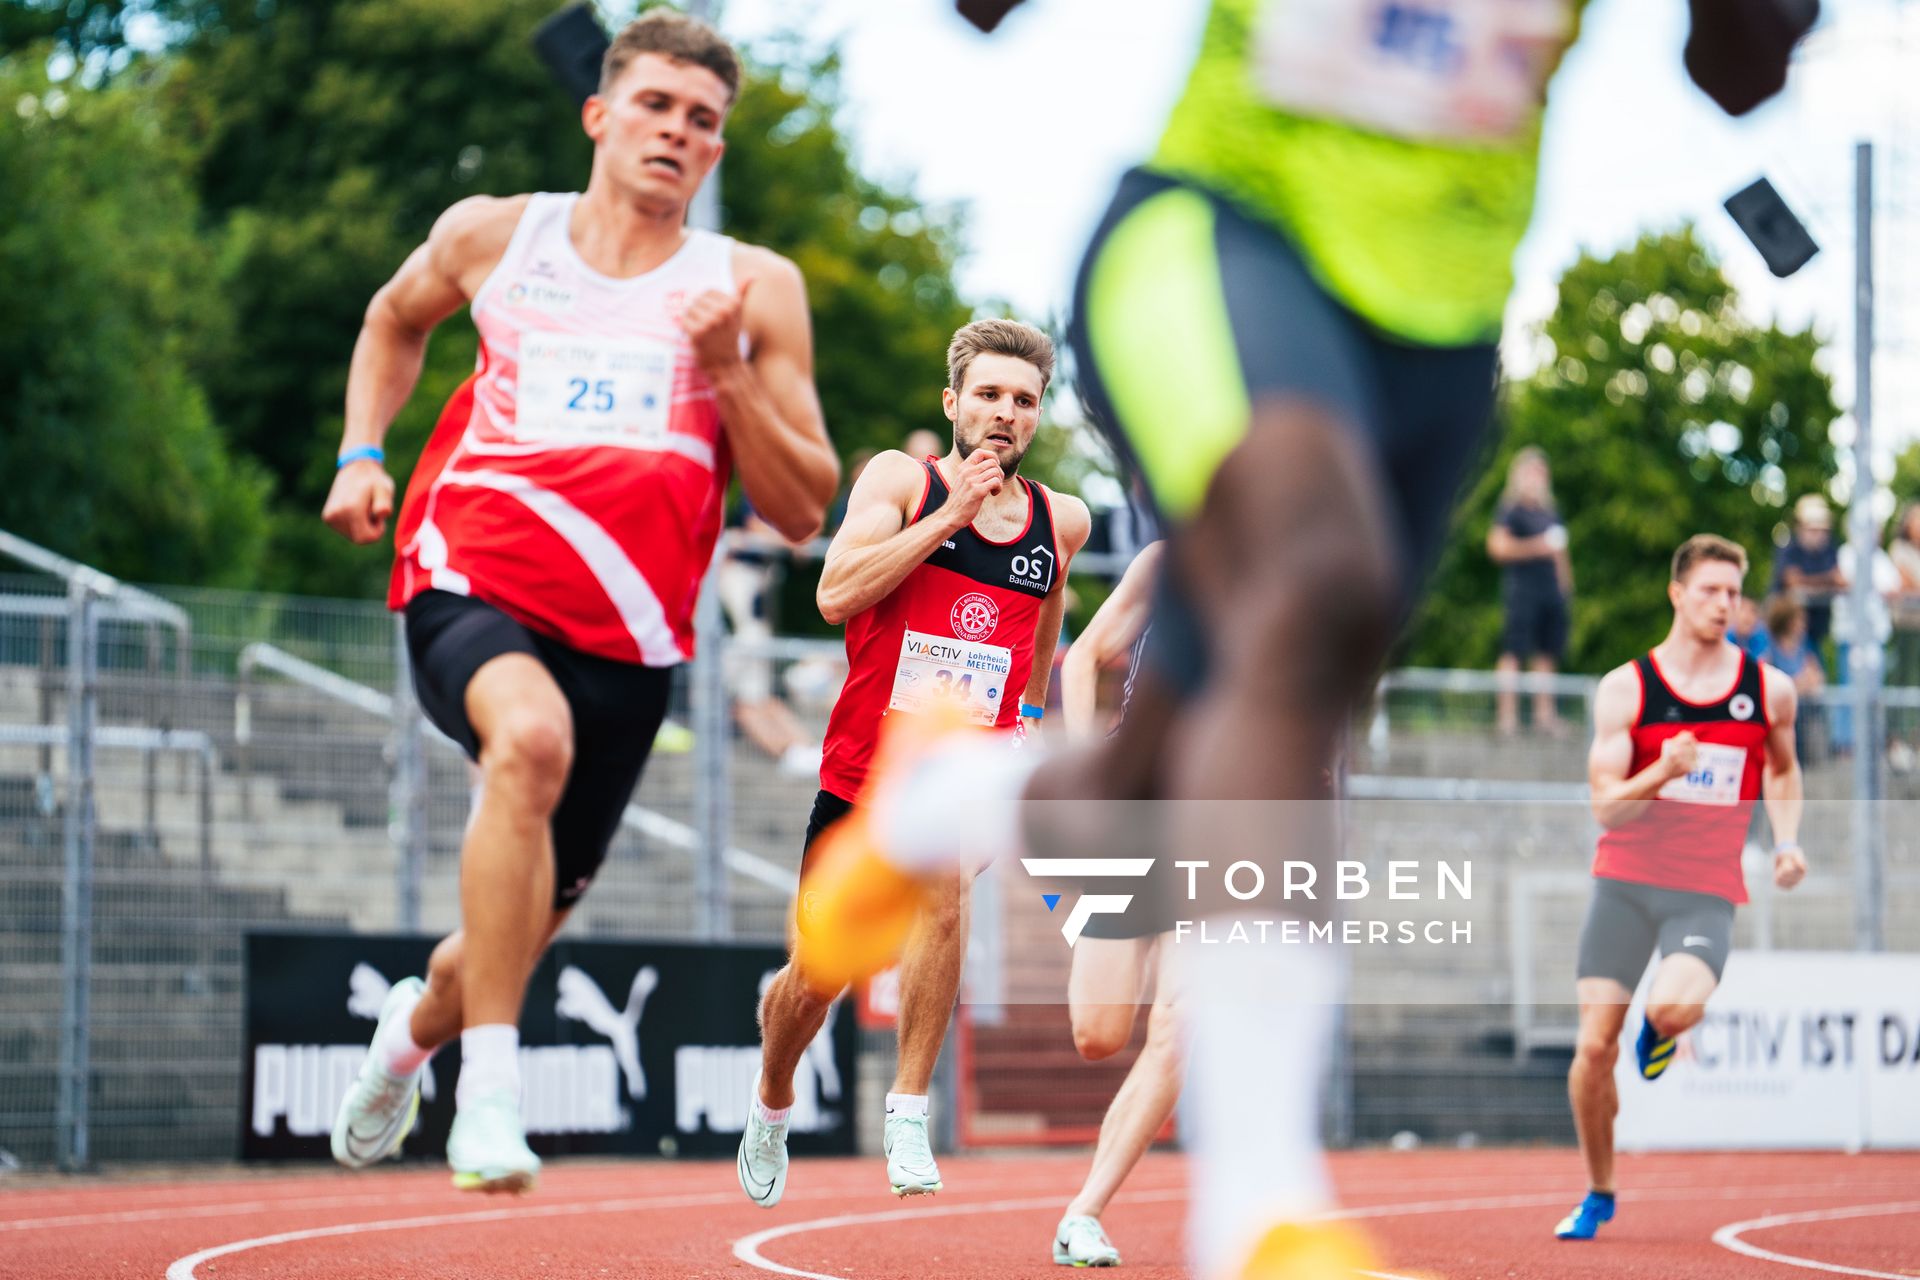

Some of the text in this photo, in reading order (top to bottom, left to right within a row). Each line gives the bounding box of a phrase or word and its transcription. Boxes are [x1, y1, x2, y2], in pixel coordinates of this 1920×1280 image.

[566, 376, 616, 413] 25
[1011, 555, 1043, 580] OS
[1009, 574, 1046, 592] BauImmo
[908, 640, 962, 660] VIACTIV
[968, 651, 1008, 665] Lohrheide
[966, 659, 1008, 674] MEETING
[932, 669, 973, 701] 34
[1802, 1010, 1857, 1068] IST
